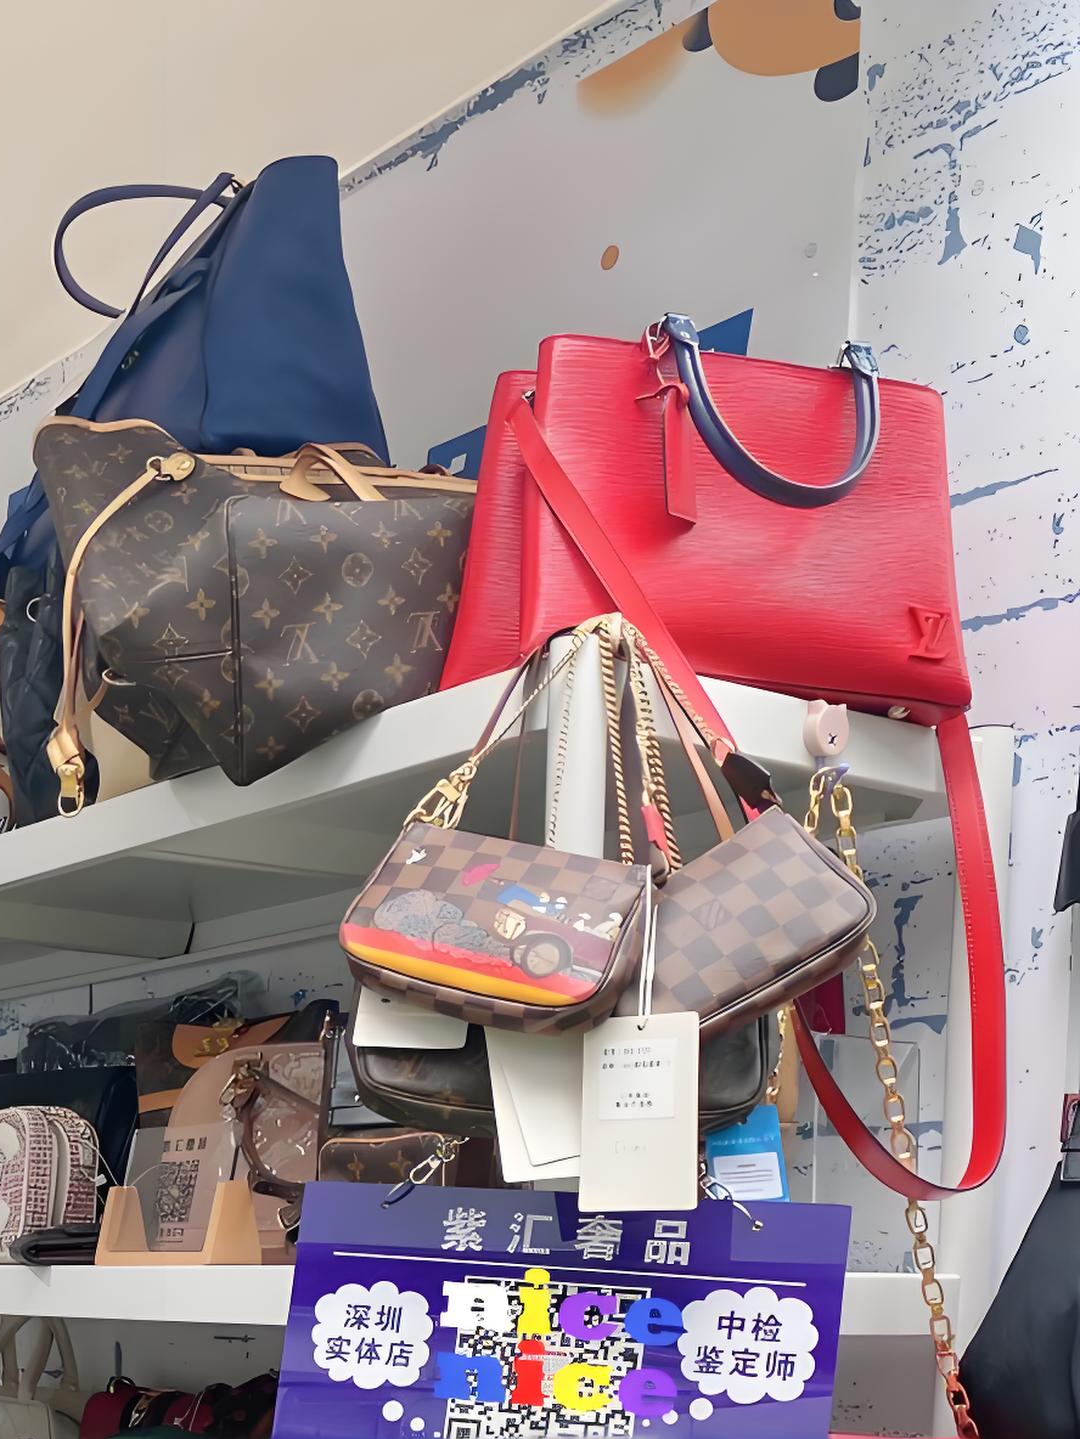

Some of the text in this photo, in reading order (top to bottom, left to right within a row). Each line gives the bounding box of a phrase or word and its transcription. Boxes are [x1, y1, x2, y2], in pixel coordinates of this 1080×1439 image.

[441, 1207, 691, 1265] 紫汇奢品
[344, 1303, 403, 1333] 深圳
[718, 1310, 783, 1343] 中检
[326, 1336, 414, 1368] 实体店
[693, 1346, 798, 1381] 鉴定师
